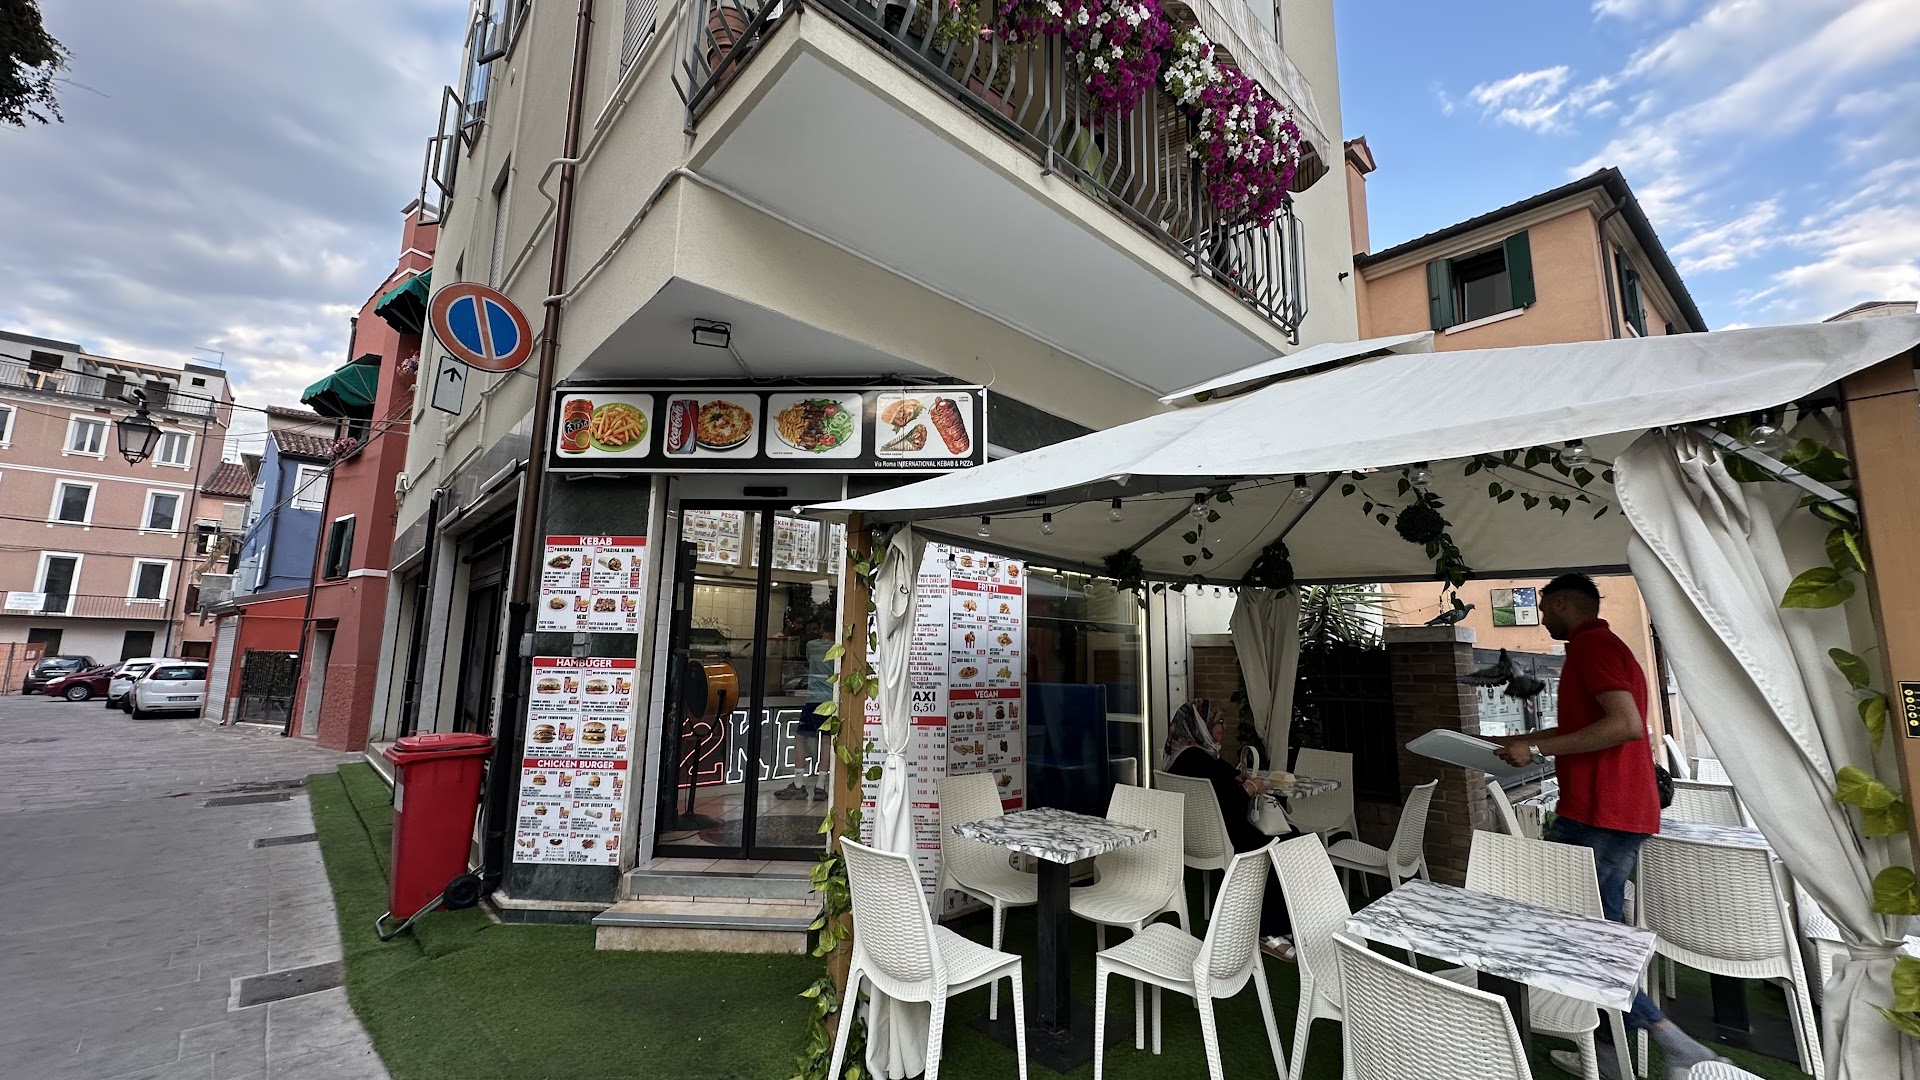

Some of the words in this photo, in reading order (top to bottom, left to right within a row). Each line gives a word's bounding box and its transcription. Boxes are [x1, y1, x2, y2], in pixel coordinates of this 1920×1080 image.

[897, 460, 936, 468] INTERNATIONAL
[579, 537, 613, 546] KEBAB
[977, 582, 999, 593] FRITTI
[556, 658, 613, 668] HAMBUGER
[912, 691, 936, 702] AXI
[975, 690, 999, 699] VEGAN
[913, 702, 936, 713] 6,50
[537, 759, 577, 768] CHICKEN
[579, 760, 615, 769] BURGER
